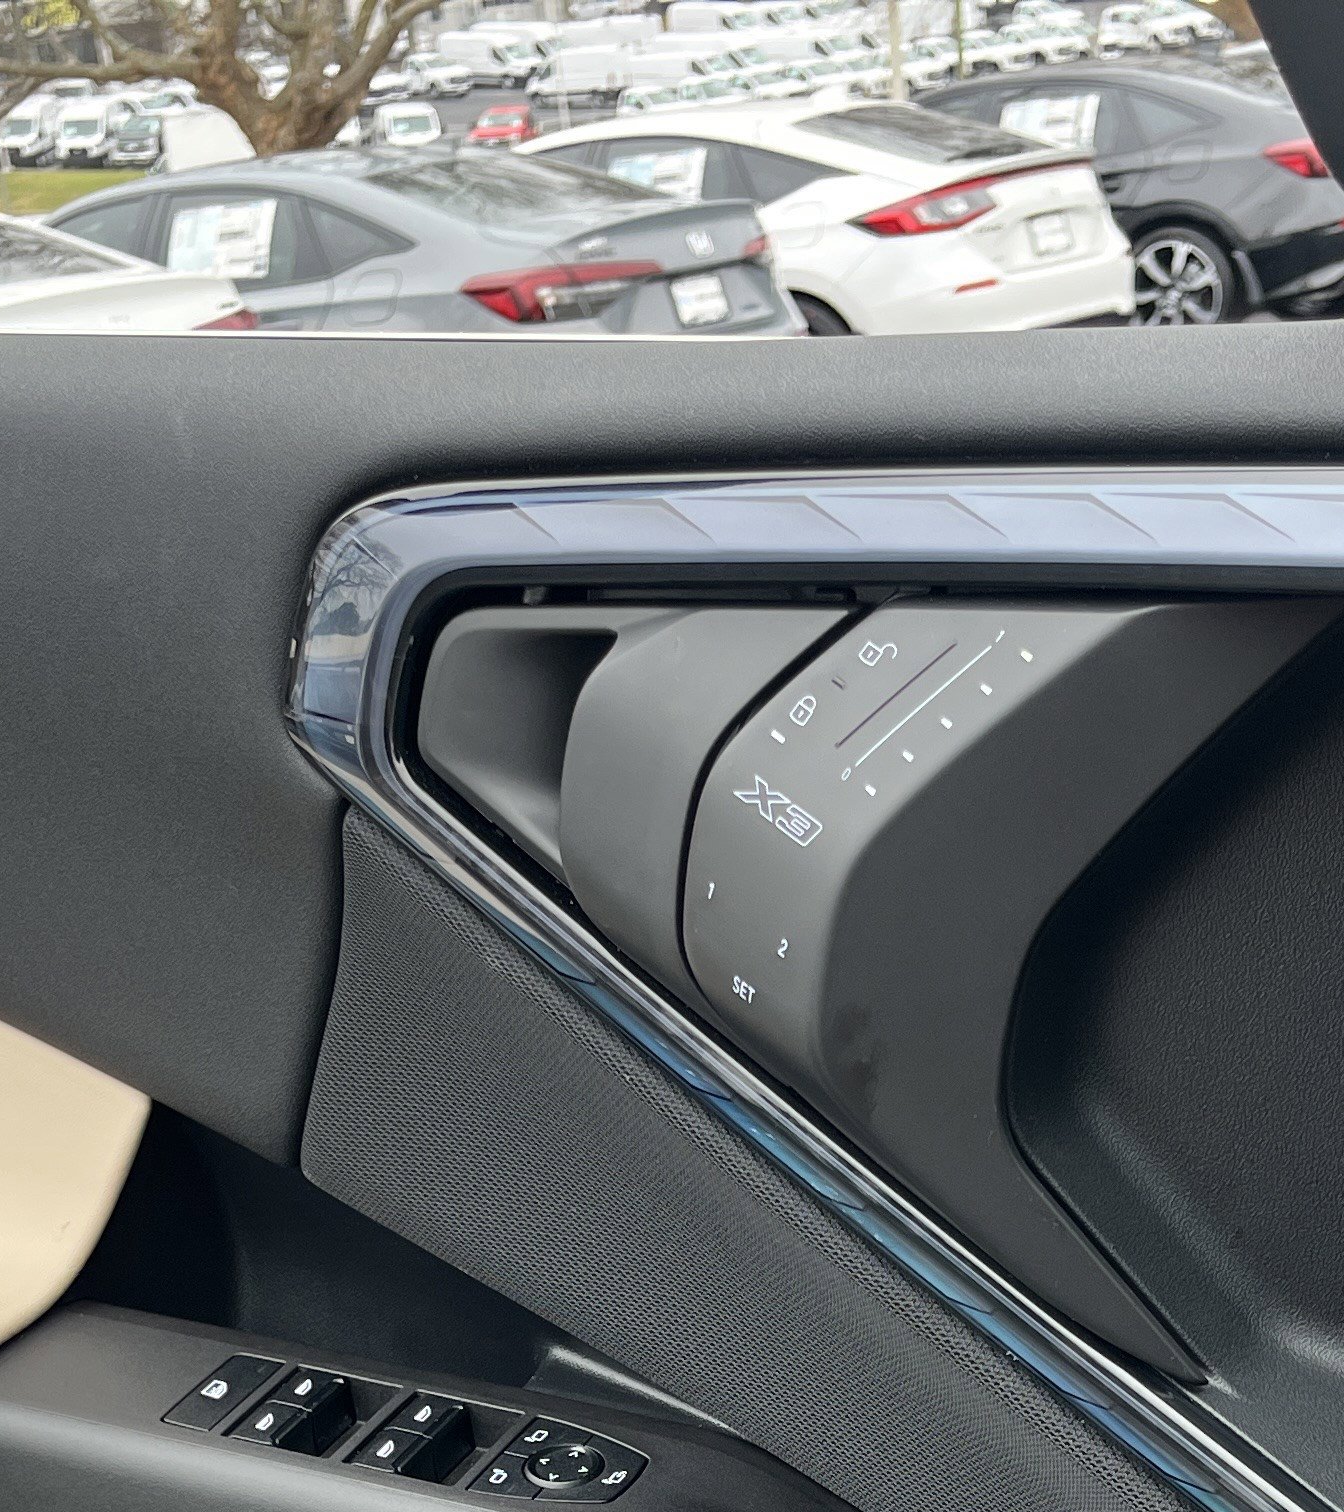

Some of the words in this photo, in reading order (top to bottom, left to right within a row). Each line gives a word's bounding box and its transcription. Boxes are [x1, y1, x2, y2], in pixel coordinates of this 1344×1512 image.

[733, 773, 823, 847] X3
[707, 881, 716, 900] 1
[777, 938, 789, 959] 2
[732, 975, 756, 1004] SET
